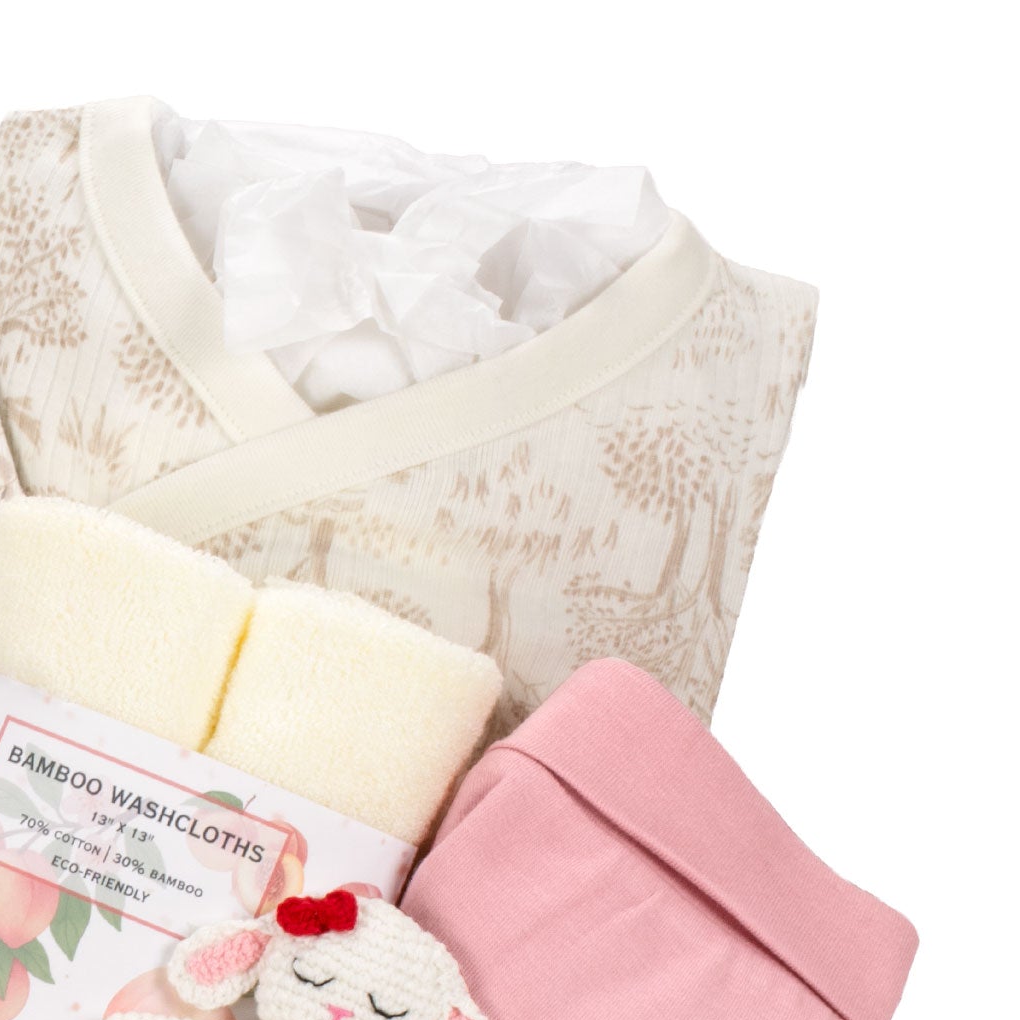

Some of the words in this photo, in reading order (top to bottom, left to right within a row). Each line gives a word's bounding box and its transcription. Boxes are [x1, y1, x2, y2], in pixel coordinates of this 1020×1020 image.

[8, 745, 103, 795] BAMBOO
[110, 785, 266, 863] WASHCLOTHS
[91, 811, 115, 827] 13"
[116, 821, 127, 834] X
[131, 827, 155, 843] 13"
[19, 813, 50, 836] 70%
[54, 829, 102, 857] COTTON
[112, 852, 145, 875] 30%
[149, 869, 204, 898] BAMBOO
[51, 855, 151, 904] ECO-FRIENDLY
